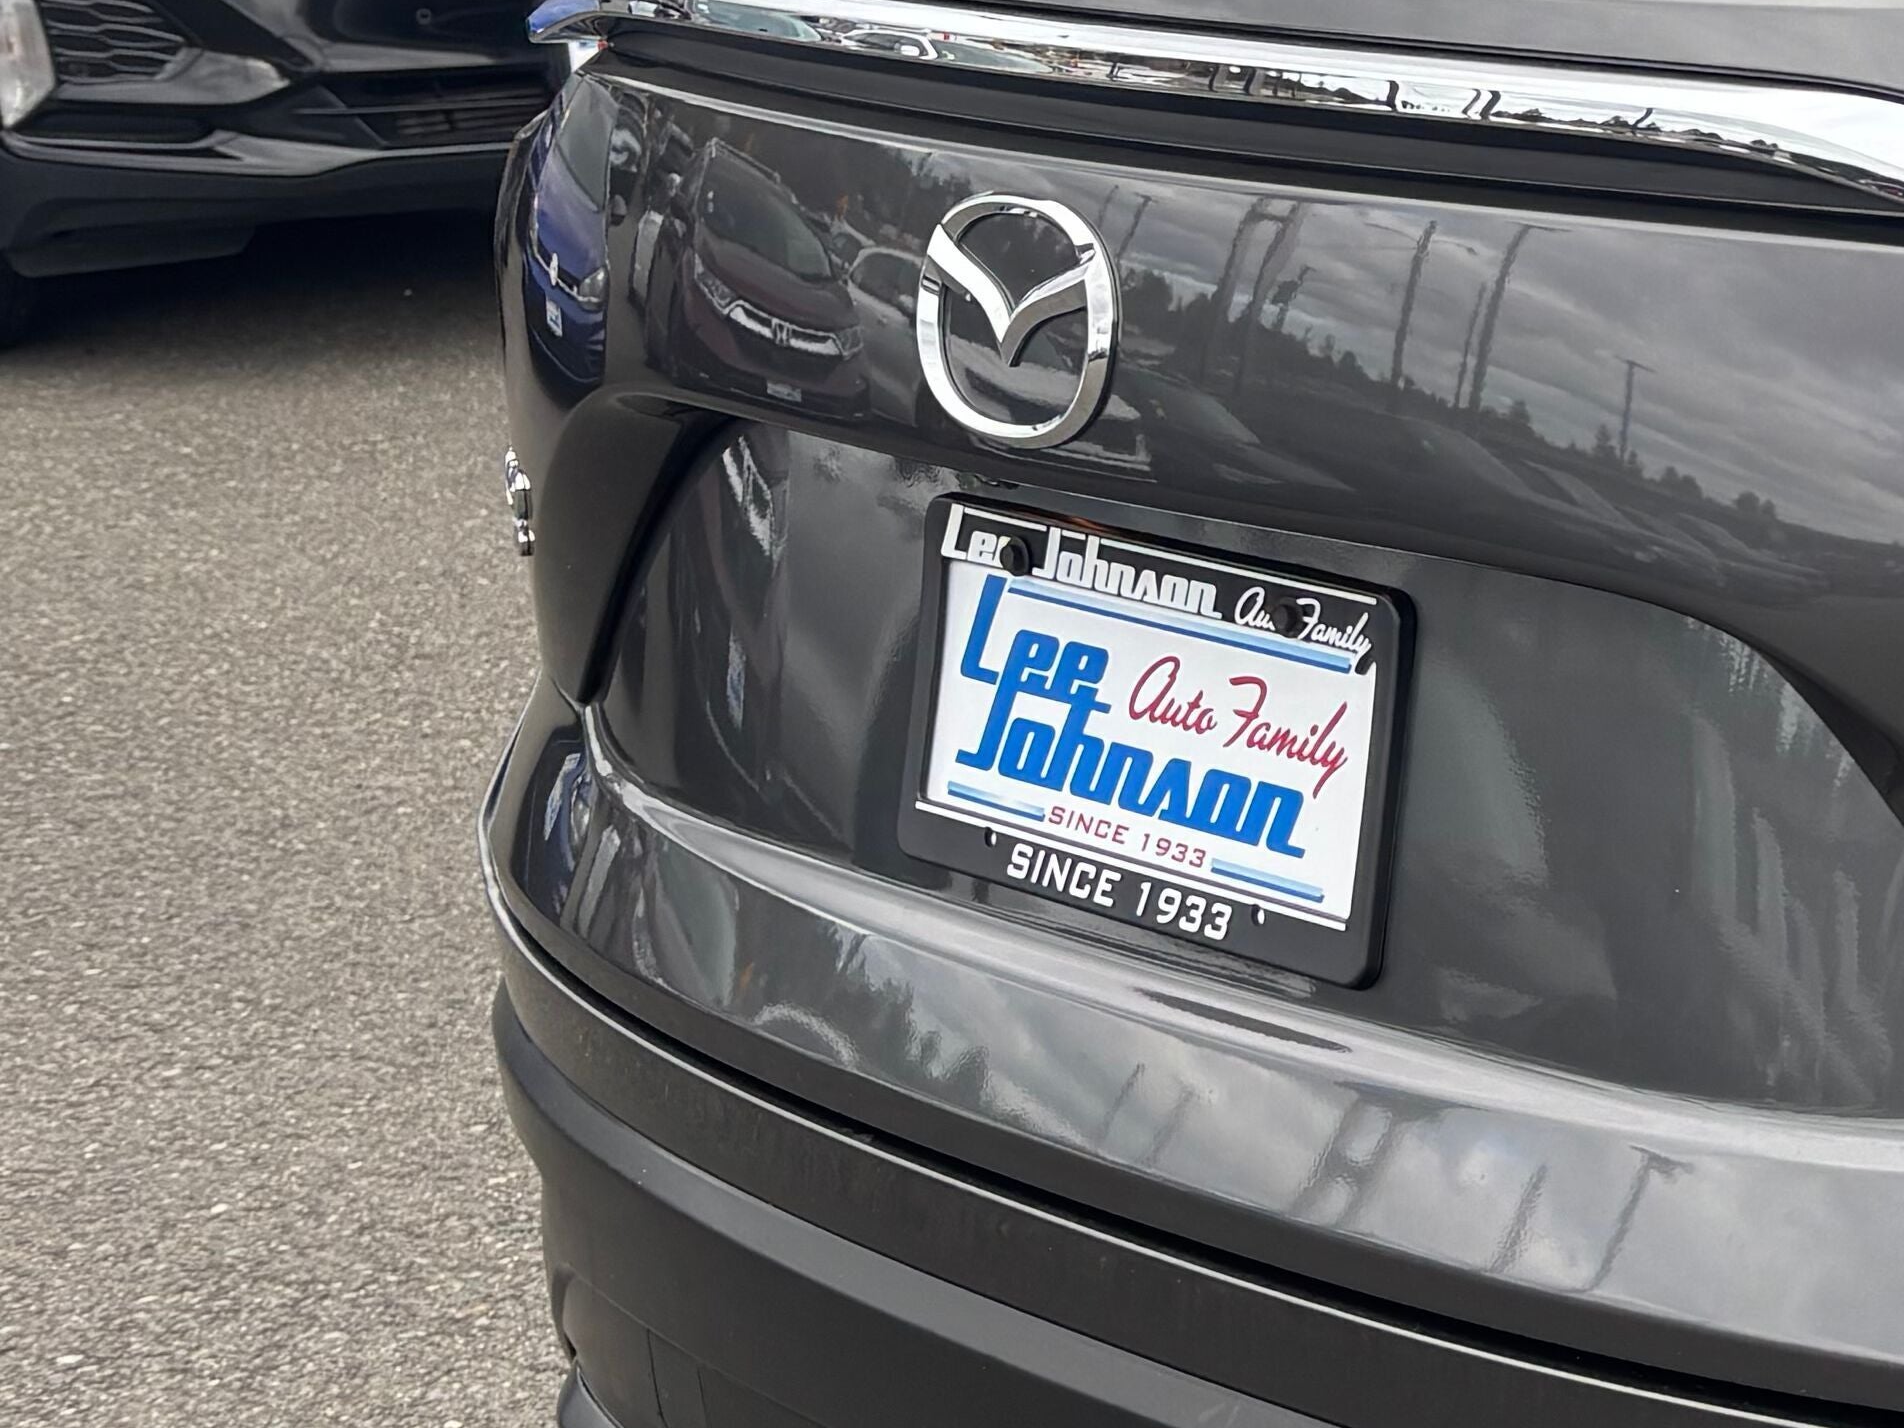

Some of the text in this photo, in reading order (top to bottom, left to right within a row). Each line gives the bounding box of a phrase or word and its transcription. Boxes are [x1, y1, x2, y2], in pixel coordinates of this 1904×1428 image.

[960, 574, 1111, 713] Lee
[1032, 527, 1221, 620] Johnson
[1234, 586, 1280, 632] Au
[1296, 598, 1372, 660] Family
[955, 684, 1305, 858] Johnson
[1128, 655, 1348, 798] Auto Family
[1006, 843, 1233, 941] SINCE 1933
[1048, 805, 1207, 868] SINCE 1933
